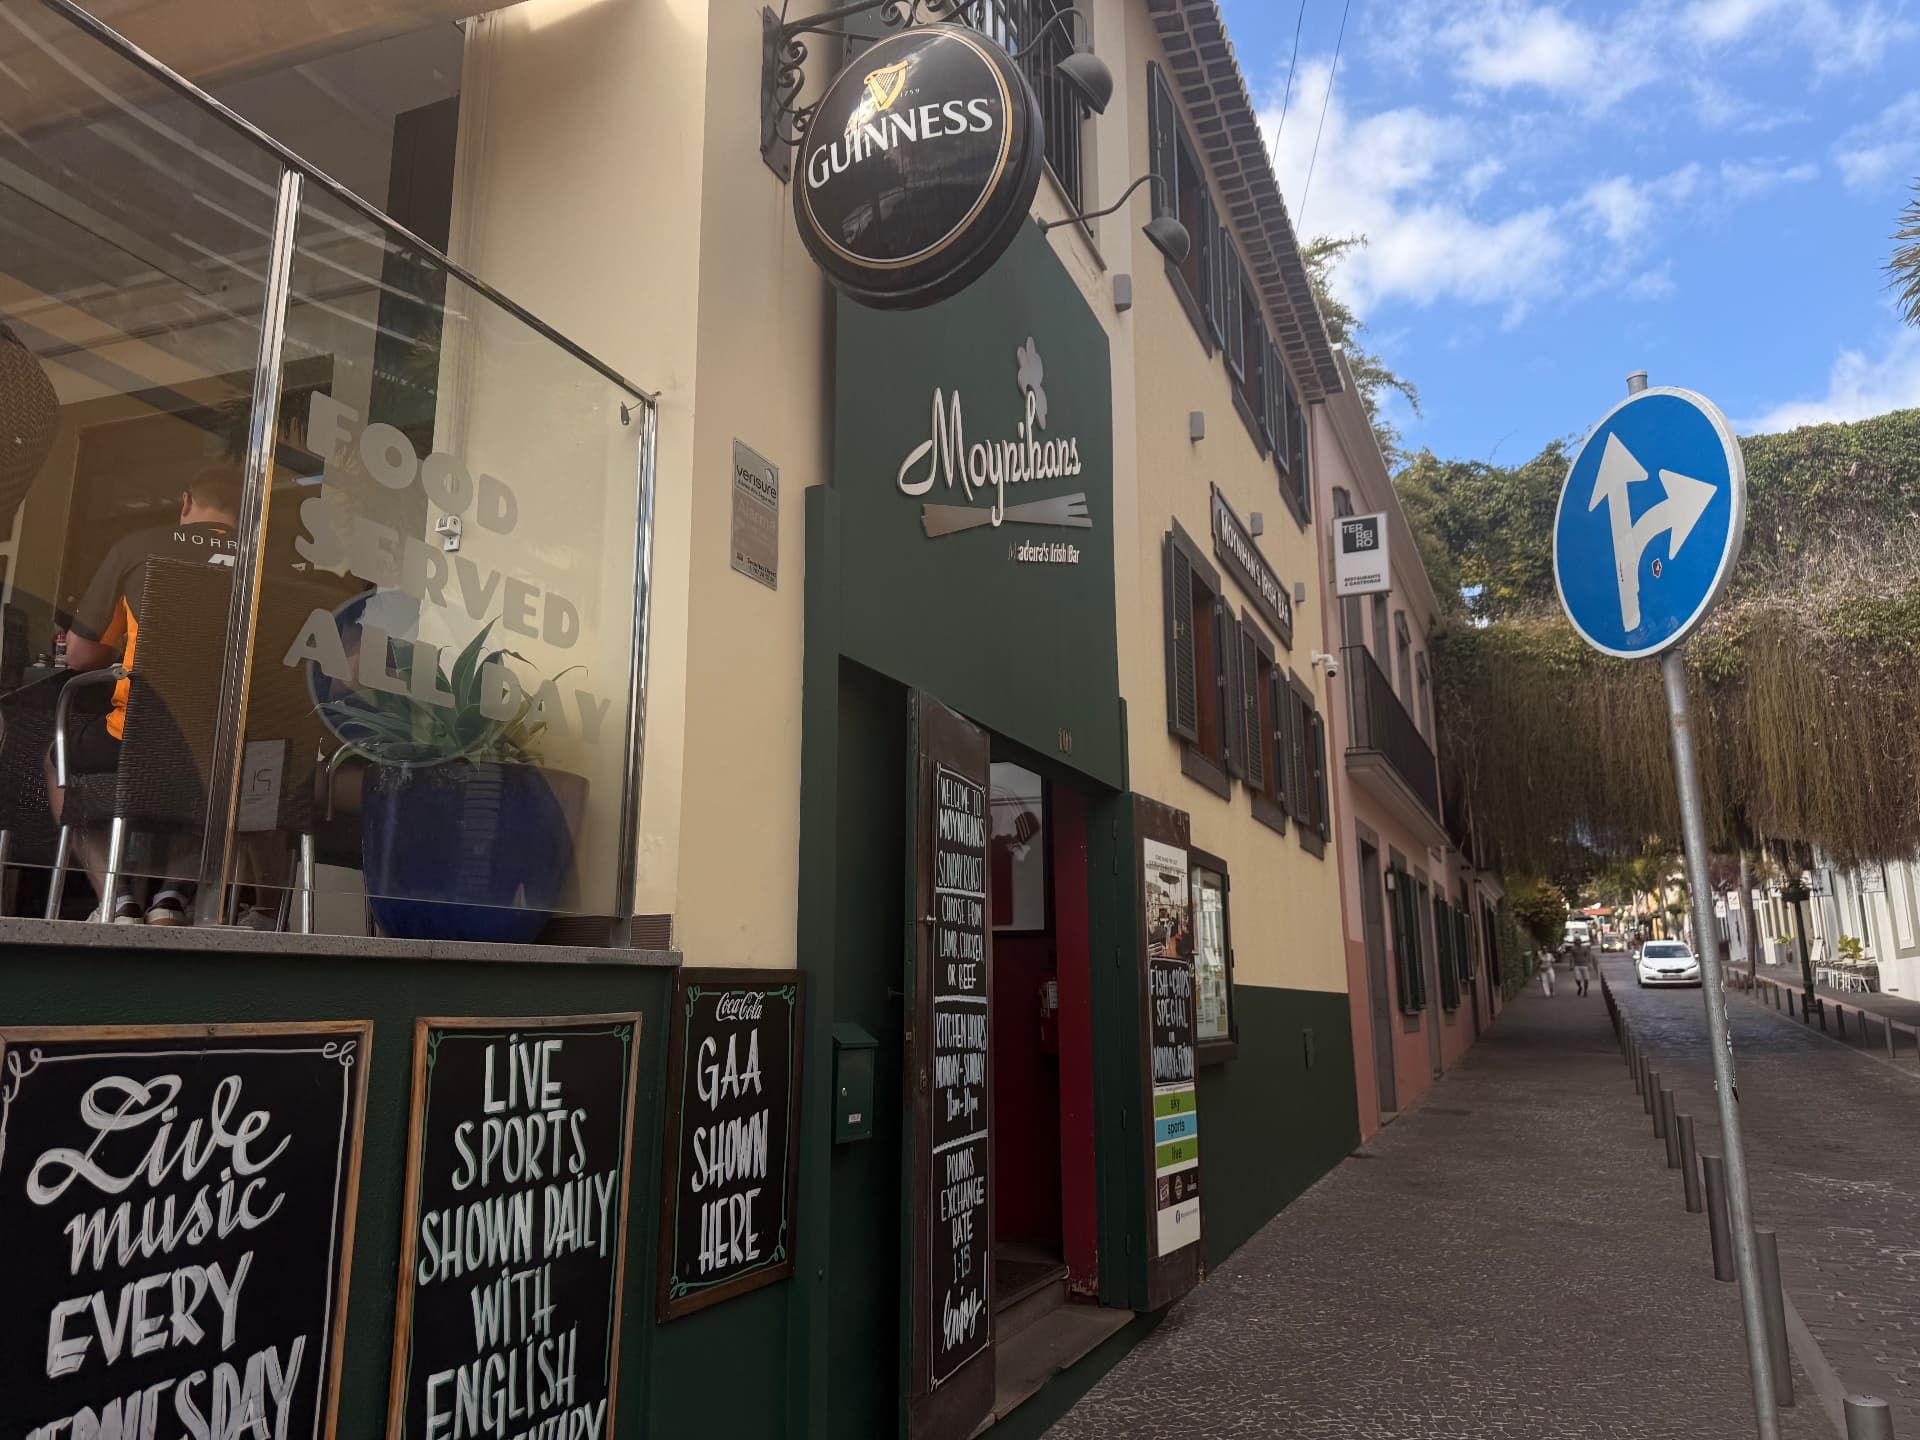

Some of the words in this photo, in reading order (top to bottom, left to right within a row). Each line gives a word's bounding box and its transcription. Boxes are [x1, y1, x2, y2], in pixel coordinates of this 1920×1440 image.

[808, 98, 993, 189] GUINNESS
[308, 390, 518, 535] FOOD
[897, 387, 1081, 527] Moynihans
[736, 464, 777, 499] verisure
[173, 531, 239, 550] NORR
[1342, 523, 1363, 534] TER
[295, 497, 580, 649] SERVED
[1008, 540, 1049, 562] Madeira's
[1050, 543, 1066, 563] Irish
[1067, 545, 1080, 564] Bar
[1277, 592, 1289, 627] BAR
[283, 607, 456, 709] ALL
[479, 661, 611, 745] DAY
[940, 776, 970, 813] WELCOME
[972, 789, 981, 817] TO
[939, 808, 985, 848] MOYNIHANS
[938, 850, 963, 889] SUNDAY
[963, 854, 983, 893] ROAST
[942, 895, 966, 925] CHOOSE
[967, 899, 982, 928] FROM
[947, 963, 957, 986] OR
[959, 963, 977, 990] BEEF
[1150, 965, 1169, 998] FISH
[936, 1012, 967, 1048] KITCHEN
[967, 1013, 987, 1052] HOURS
[1156, 994, 1188, 1029] SPECIAL
[483, 1033, 564, 1115] LIVE
[697, 1028, 763, 1111] GAA
[935, 1053, 960, 1089] MONDAY
[964, 1052, 985, 1089] SUNDAY
[1170, 1094, 1180, 1113] sky
[26, 1074, 292, 1205] Live
[1168, 1119, 1185, 1138] sports
[451, 1109, 587, 1192] SPORTS
[691, 1109, 769, 1193] SHOWN
[946, 1147, 975, 1187] POUNDS
[1172, 1146, 1182, 1161] live
[940, 1176, 985, 1222] EXCHANGE
[64, 1167, 286, 1276] music
[418, 1191, 532, 1286] SHOWN
[543, 1168, 617, 1259] DAILY
[698, 1187, 761, 1275] HERE
[952, 1210, 974, 1249] RATE
[45, 1251, 254, 1379] EVERY
[471, 1263, 557, 1354] WITH
[425, 1328, 577, 1440] ENGLISH
